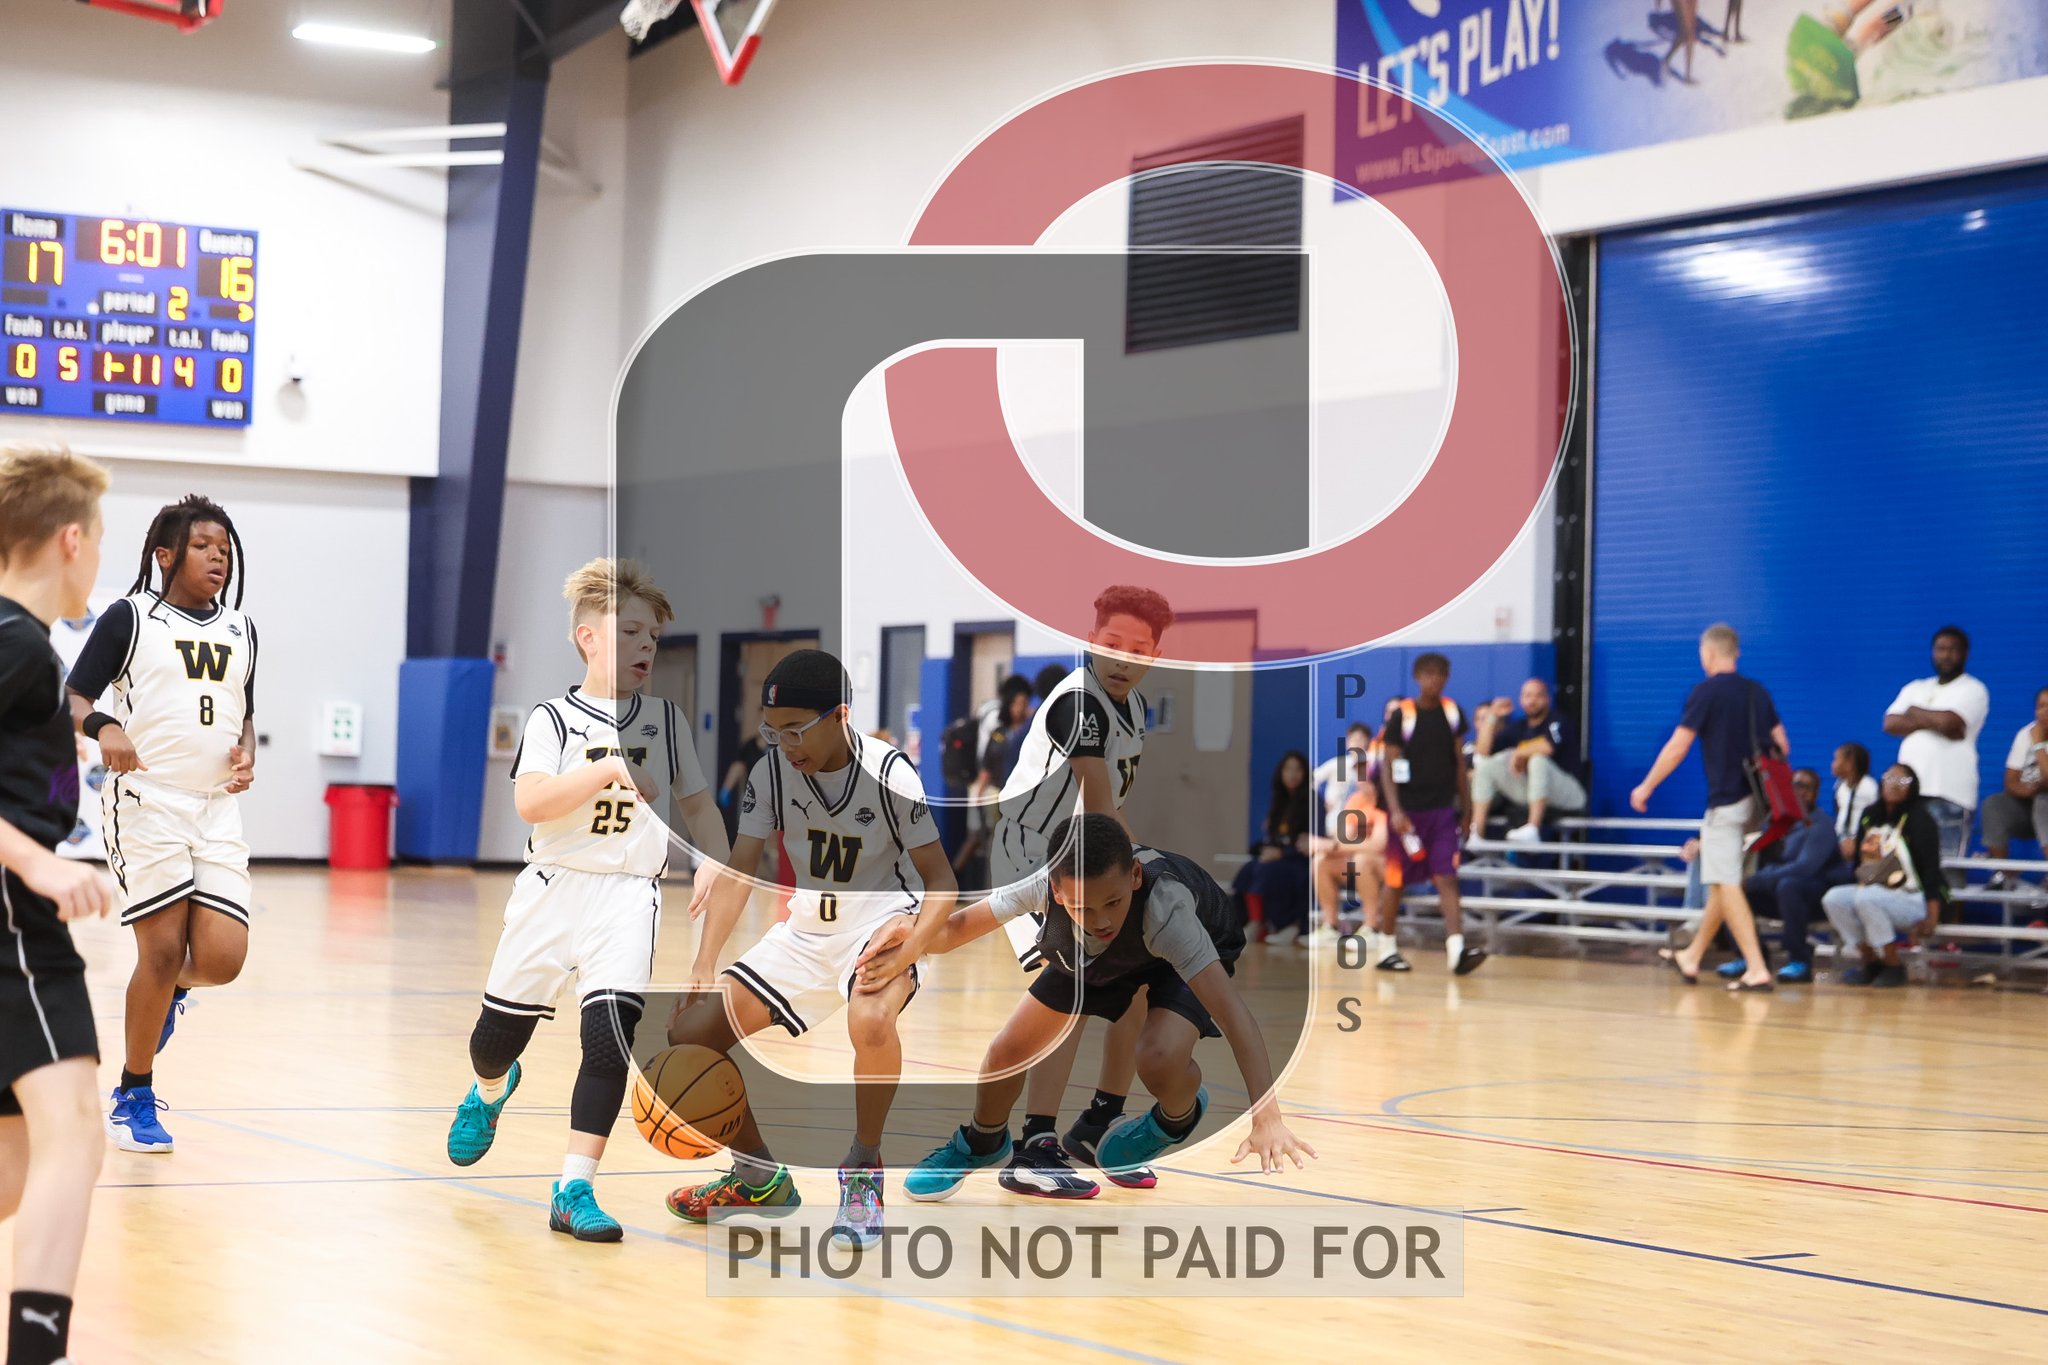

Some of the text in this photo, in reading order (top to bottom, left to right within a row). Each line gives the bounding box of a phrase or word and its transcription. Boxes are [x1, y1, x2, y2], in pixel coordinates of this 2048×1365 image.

[1356, 0, 1561, 138] LET'S PLAY!
[100, 219, 187, 268] 6:01
[29, 241, 63, 285] 17
[220, 256, 254, 302] 16
[167, 286, 188, 321] 2
[16, 343, 36, 378] 0
[58, 346, 78, 381] 5
[174, 356, 194, 388] 4
[221, 357, 243, 393] 0
[175, 639, 233, 682] W
[199, 695, 214, 726] 8
[590, 800, 635, 836] 25
[807, 828, 863, 883] W
[819, 891, 837, 922] 0
